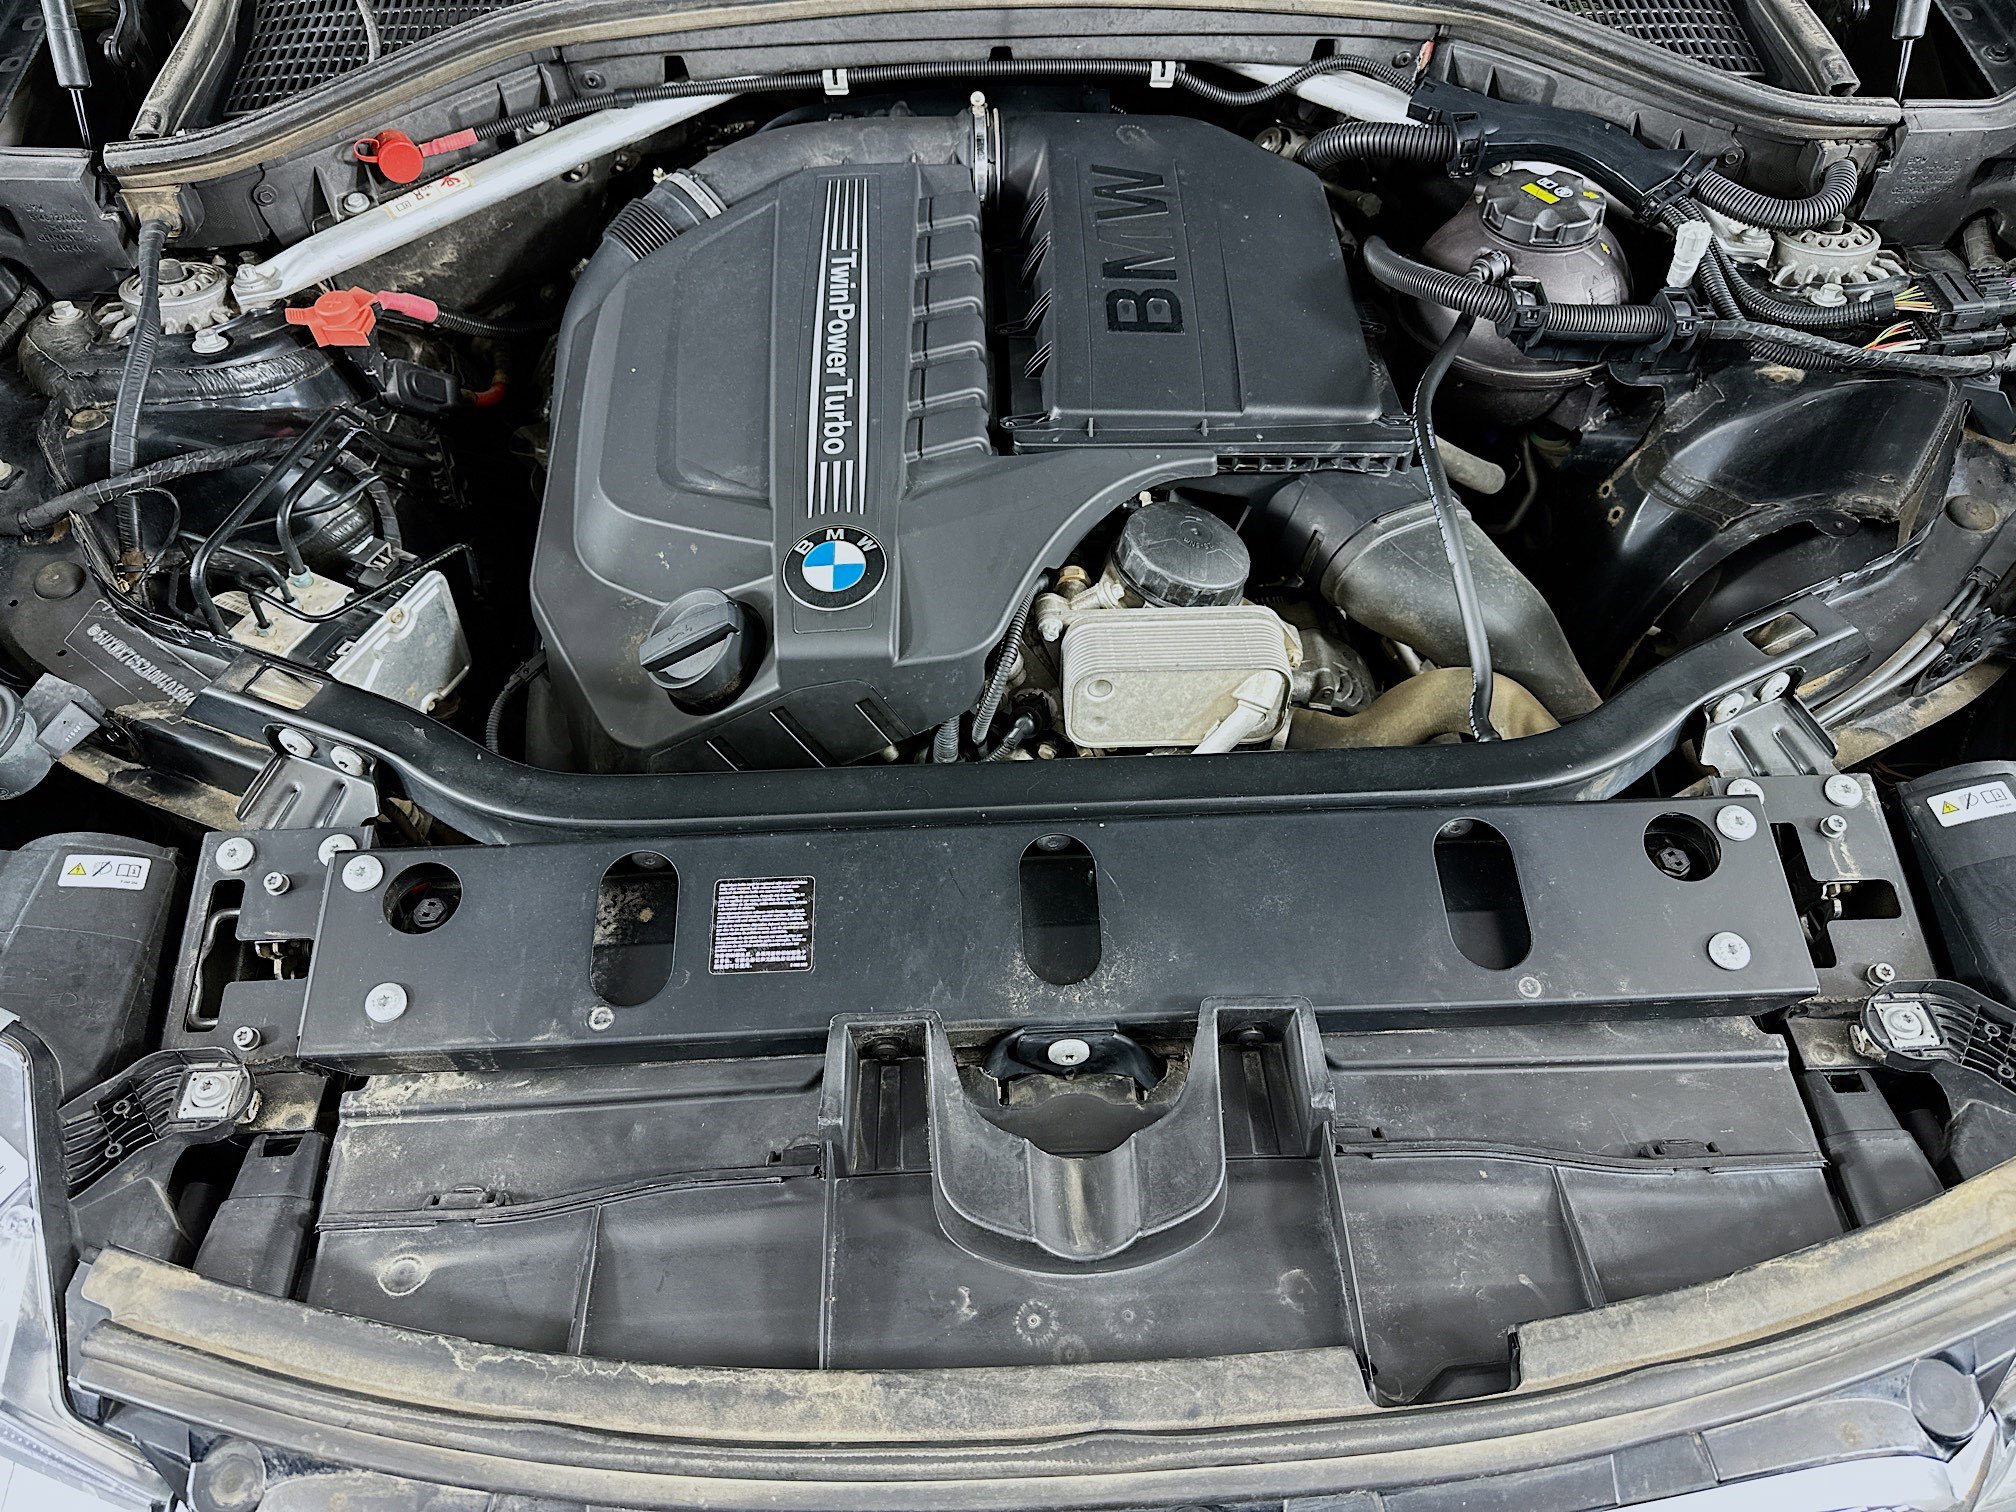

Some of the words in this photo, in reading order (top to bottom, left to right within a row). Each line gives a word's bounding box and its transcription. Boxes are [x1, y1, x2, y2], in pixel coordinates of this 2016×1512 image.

[1090, 164, 1184, 335] BMW
[825, 251, 857, 377] TwinPower
[823, 378, 854, 455] Turbo
[794, 528, 878, 556] BMW
